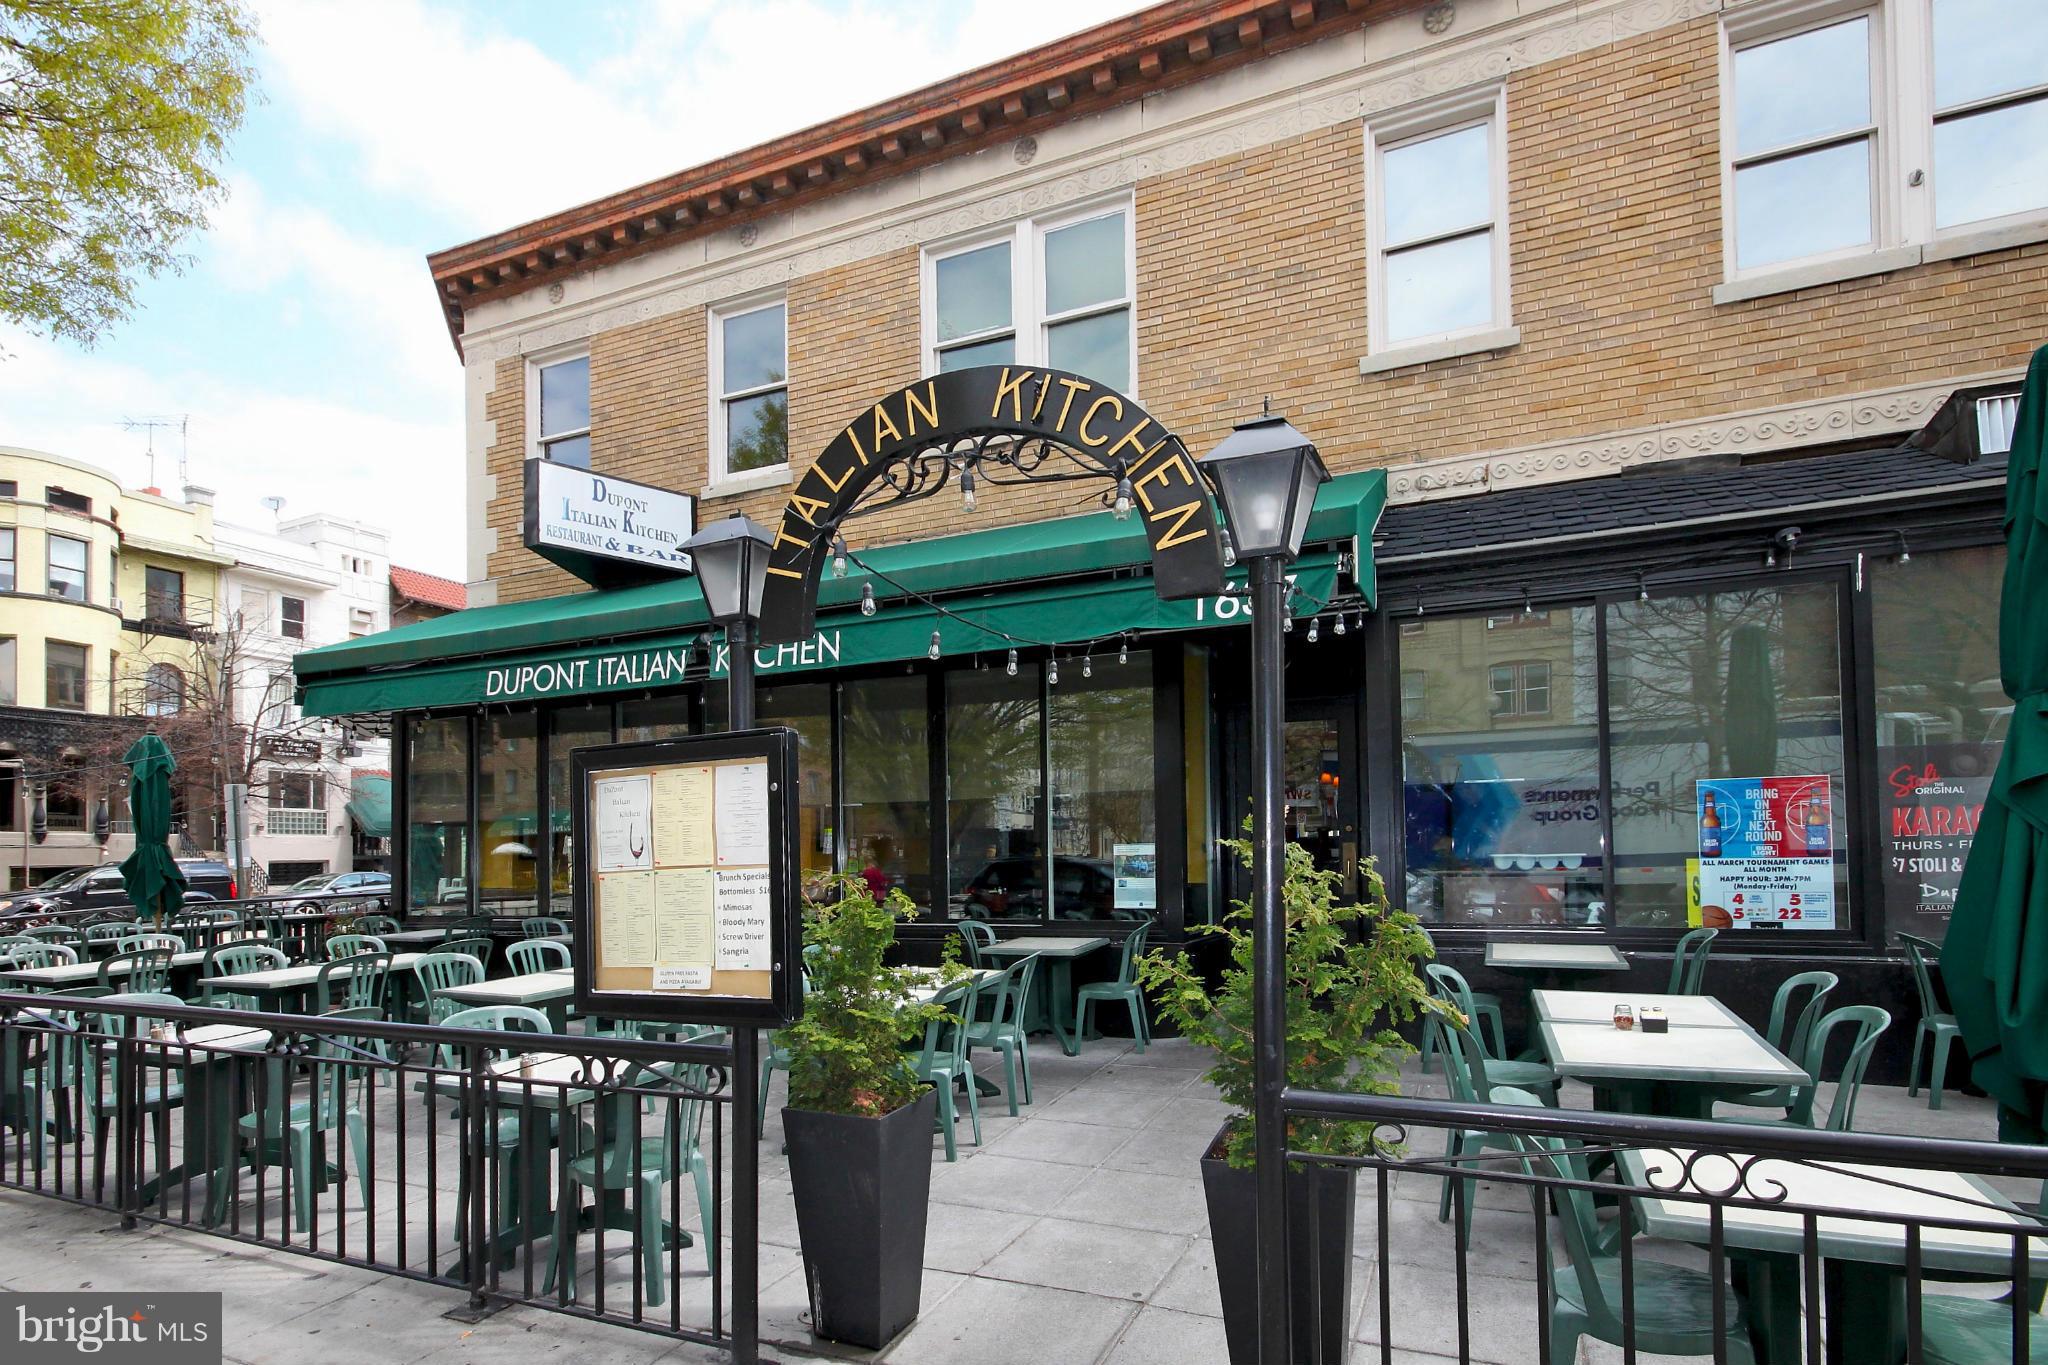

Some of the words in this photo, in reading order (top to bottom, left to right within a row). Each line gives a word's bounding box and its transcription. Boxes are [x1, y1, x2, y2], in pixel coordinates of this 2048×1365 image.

[767, 381, 940, 579] ITALIAN
[992, 367, 1208, 551] KITCHEN
[546, 524, 603, 547] RESTAURANT
[604, 536, 621, 552] &
[626, 543, 690, 566] BAR
[486, 660, 589, 697] DUPONT
[597, 648, 687, 687] ITALIAN
[714, 630, 841, 673] KCHEN
[1888, 763, 1941, 798] Stoli
[1745, 789, 1779, 800] BRING
[1915, 786, 1965, 795] ORIGINAL
[1754, 799, 1770, 810] ON
[1751, 810, 1773, 820] THE
[1749, 821, 1777, 831] NEXT
[1745, 831, 1783, 842] ROUND
[1892, 840, 1943, 851] THURS
[1892, 857, 1905, 873] $7
[1908, 858, 1947, 873] STOLI
[1950, 857, 1963, 872] &
[719, 873, 742, 882] Brunch
[742, 871, 771, 882] Specials
[719, 886, 756, 896] Bottomless
[1733, 883, 1798, 891] (Monday-Friday)
[1918, 883, 1959, 902] Dup
[1732, 893, 1745, 905] 4
[1789, 893, 1802, 906] 5
[1733, 908, 1745, 920] 5
[1778, 908, 1802, 920] 22
[722, 918, 746, 927] Bloody
[747, 918, 765, 927] Mary
[722, 933, 743, 941] Screw
[744, 932, 765, 940] Driver
[722, 947, 749, 957] Sangria
